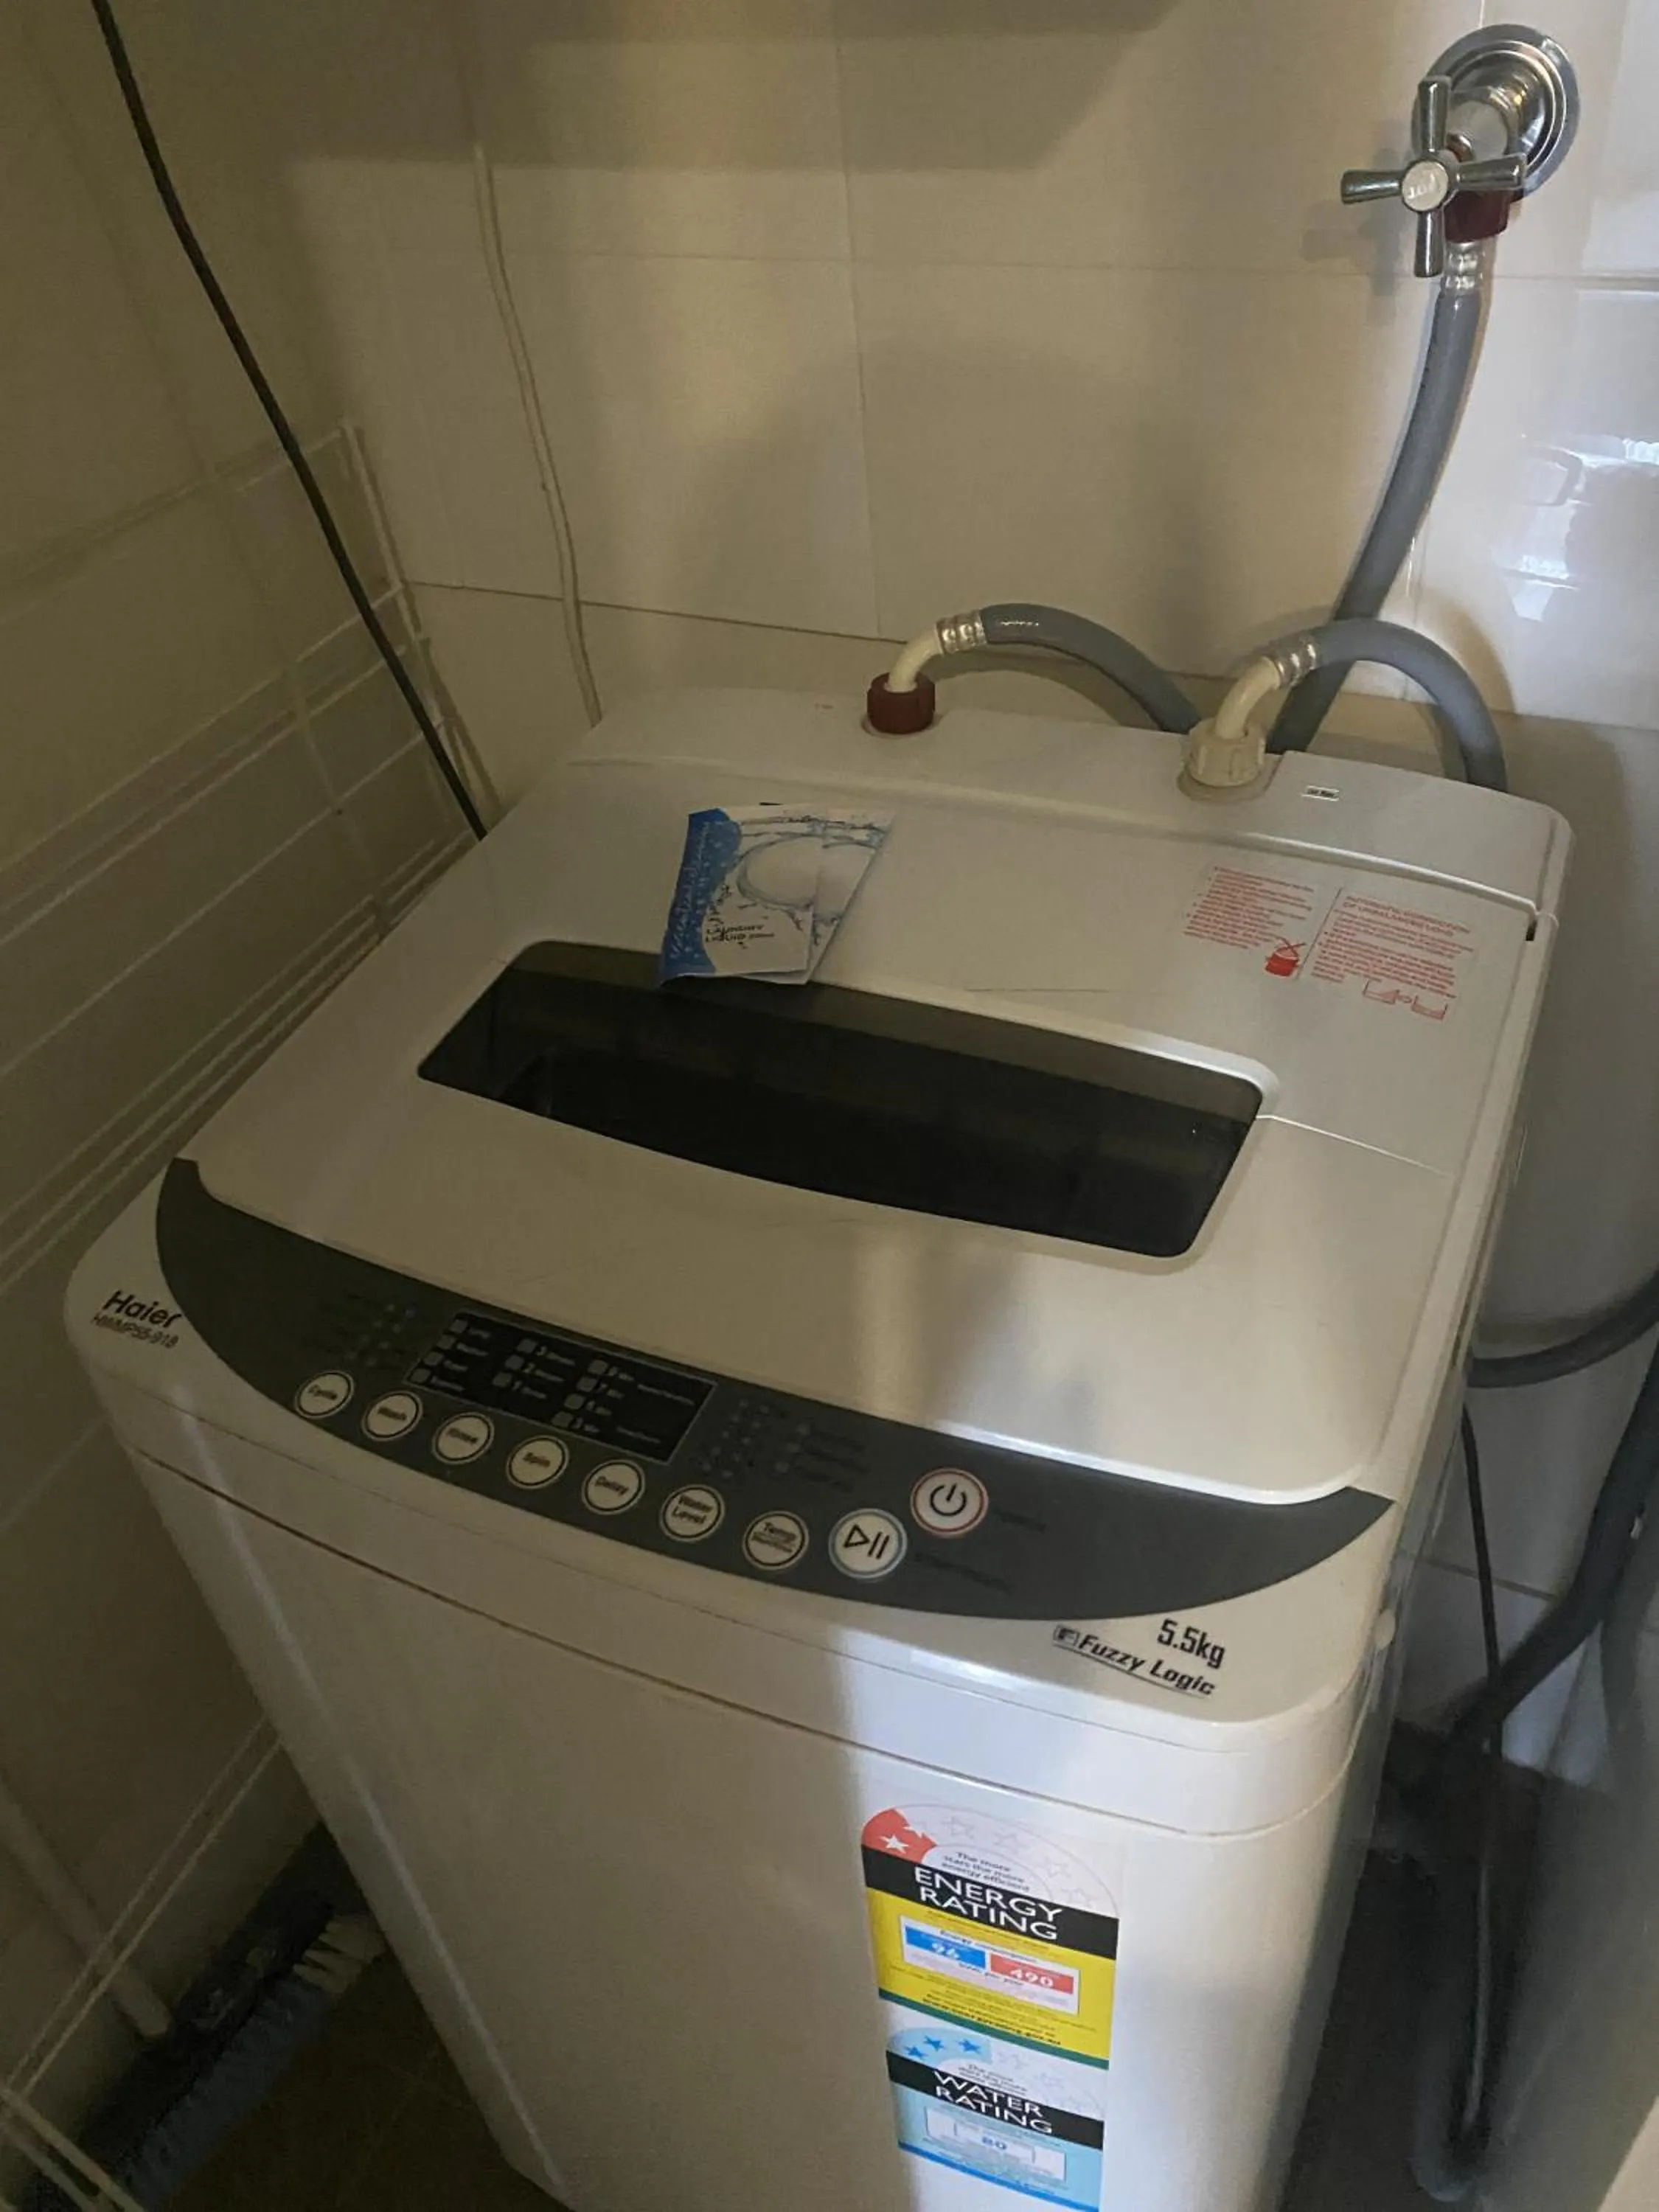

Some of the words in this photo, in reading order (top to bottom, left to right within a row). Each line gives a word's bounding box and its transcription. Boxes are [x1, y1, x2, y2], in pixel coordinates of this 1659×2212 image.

[102, 1290, 182, 1328] Haier
[1078, 1633, 1145, 1672] Fuzzy
[1150, 1659, 1217, 1697] Logic
[1158, 1618, 1225, 1670] 5.5kg
[914, 1867, 1062, 1922] ENERGY
[920, 1887, 1058, 1941] RATING
[1010, 1968, 1054, 1988] 490
[934, 2070, 1044, 2118] WATER
[936, 2086, 1053, 2135] RATING
